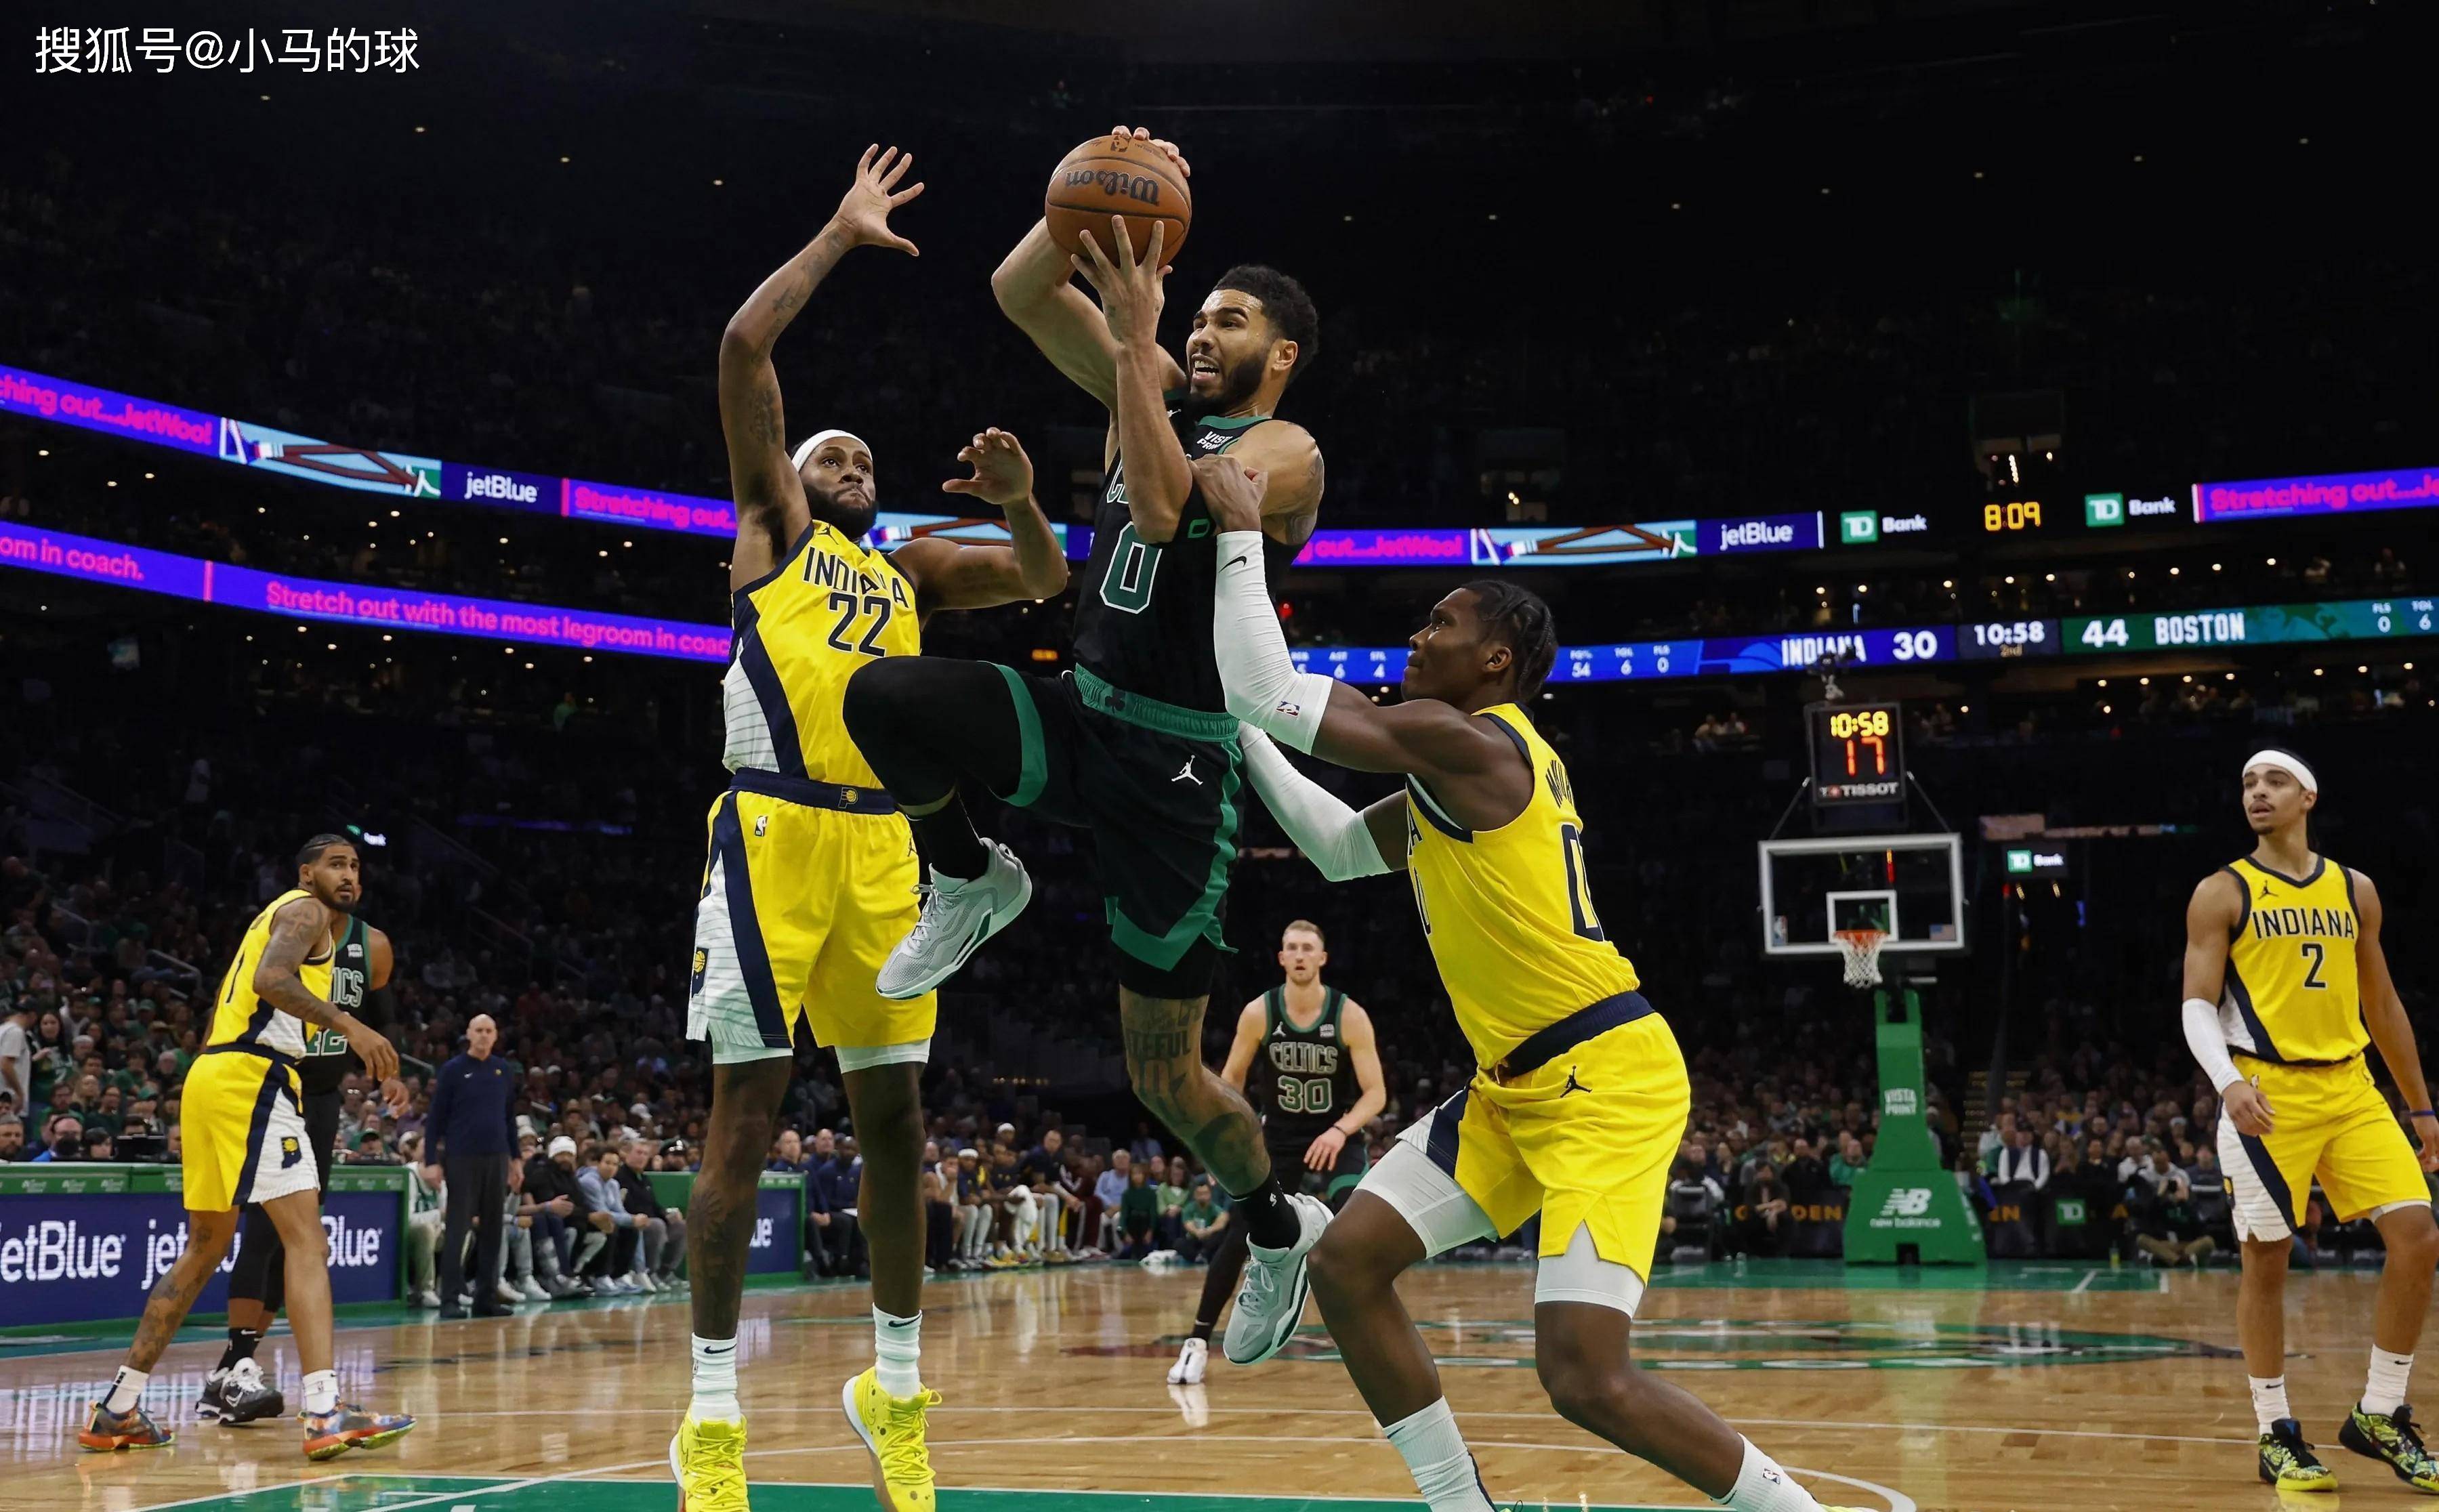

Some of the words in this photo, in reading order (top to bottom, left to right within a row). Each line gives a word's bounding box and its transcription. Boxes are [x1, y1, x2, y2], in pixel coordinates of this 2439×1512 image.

[1064, 169, 1160, 207] Wilson
[465, 471, 538, 503] jetBlue
[2210, 483, 2348, 511] Stretching
[575, 486, 690, 529] Stretching
[2089, 499, 2121, 520] TD
[2129, 497, 2176, 516] Bank
[1719, 521, 1793, 551] jetBlue
[1844, 516, 1875, 537] TD
[1882, 514, 1927, 533] Bank
[41, 538, 62, 566] in
[266, 581, 354, 614] Stretch
[357, 598, 400, 620] out
[402, 600, 455, 626] with
[459, 605, 498, 631] the
[501, 614, 560, 637] most
[562, 616, 652, 648] legroom
[656, 626, 678, 650] in
[828, 591, 892, 658] 22
[2082, 618, 2129, 648] 44
[2154, 612, 2245, 645] BOSTON
[2377, 616, 2392, 633] 0
[2419, 613, 2432, 631] 6
[1893, 630, 1938, 660] 30
[1974, 621, 2045, 646] 10:58
[1333, 663, 1346, 679] 6
[1373, 663, 1385, 679] 4
[1621, 659, 1632, 676] 6
[1656, 657, 1669, 674] 0
[1831, 711, 1889, 738] 10:58
[1847, 736, 1884, 776] 17
[2252, 908, 2355, 940] INDIANA
[2301, 942, 2328, 990] 2
[1269, 1042, 1339, 1074] CELTICS
[1277, 1074, 1333, 1114] 30
[0, 1219, 127, 1283] etBlue
